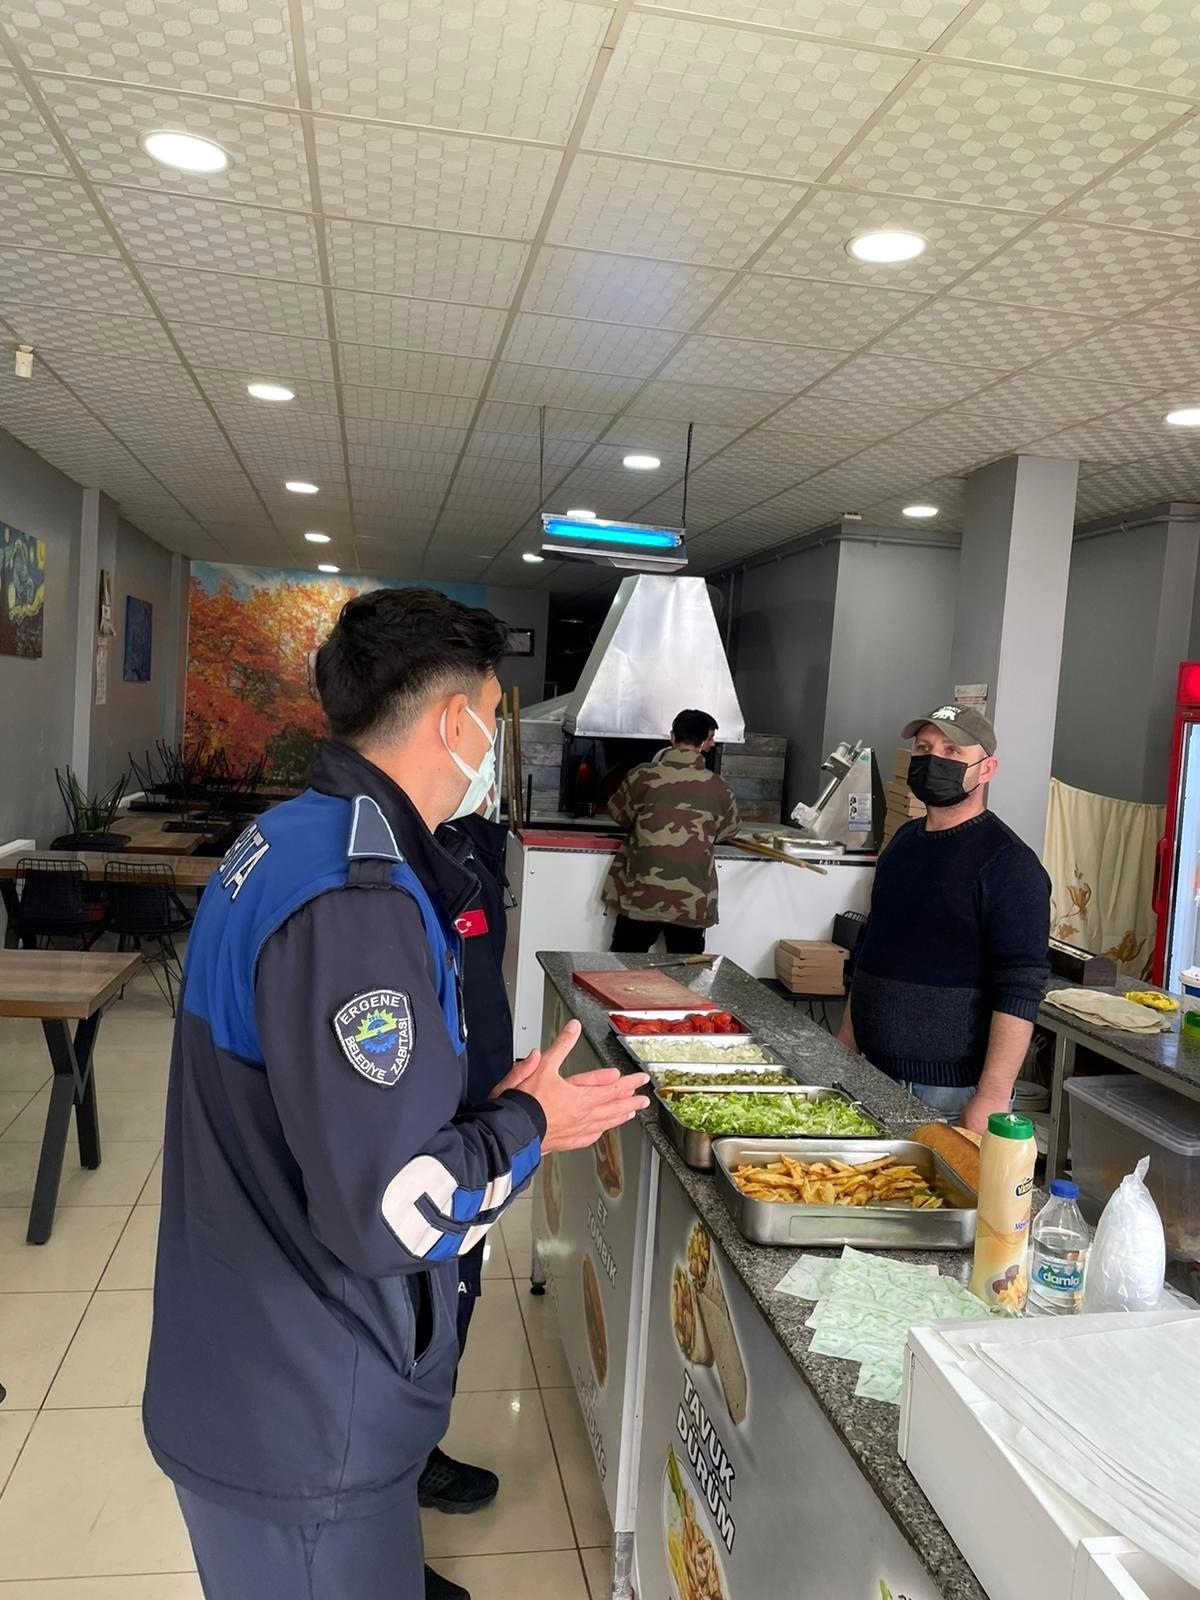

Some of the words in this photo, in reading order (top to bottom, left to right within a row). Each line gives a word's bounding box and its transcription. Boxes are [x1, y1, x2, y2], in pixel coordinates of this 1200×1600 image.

[340, 994, 400, 1025] ERGENE
[345, 1035, 387, 1080] BELEDİYE
[390, 1018, 408, 1075] ZABITASI
[1043, 1272, 1079, 1286] damla
[683, 1368, 736, 1501] TAVUK
[676, 1403, 736, 1555] DÜRÜM
